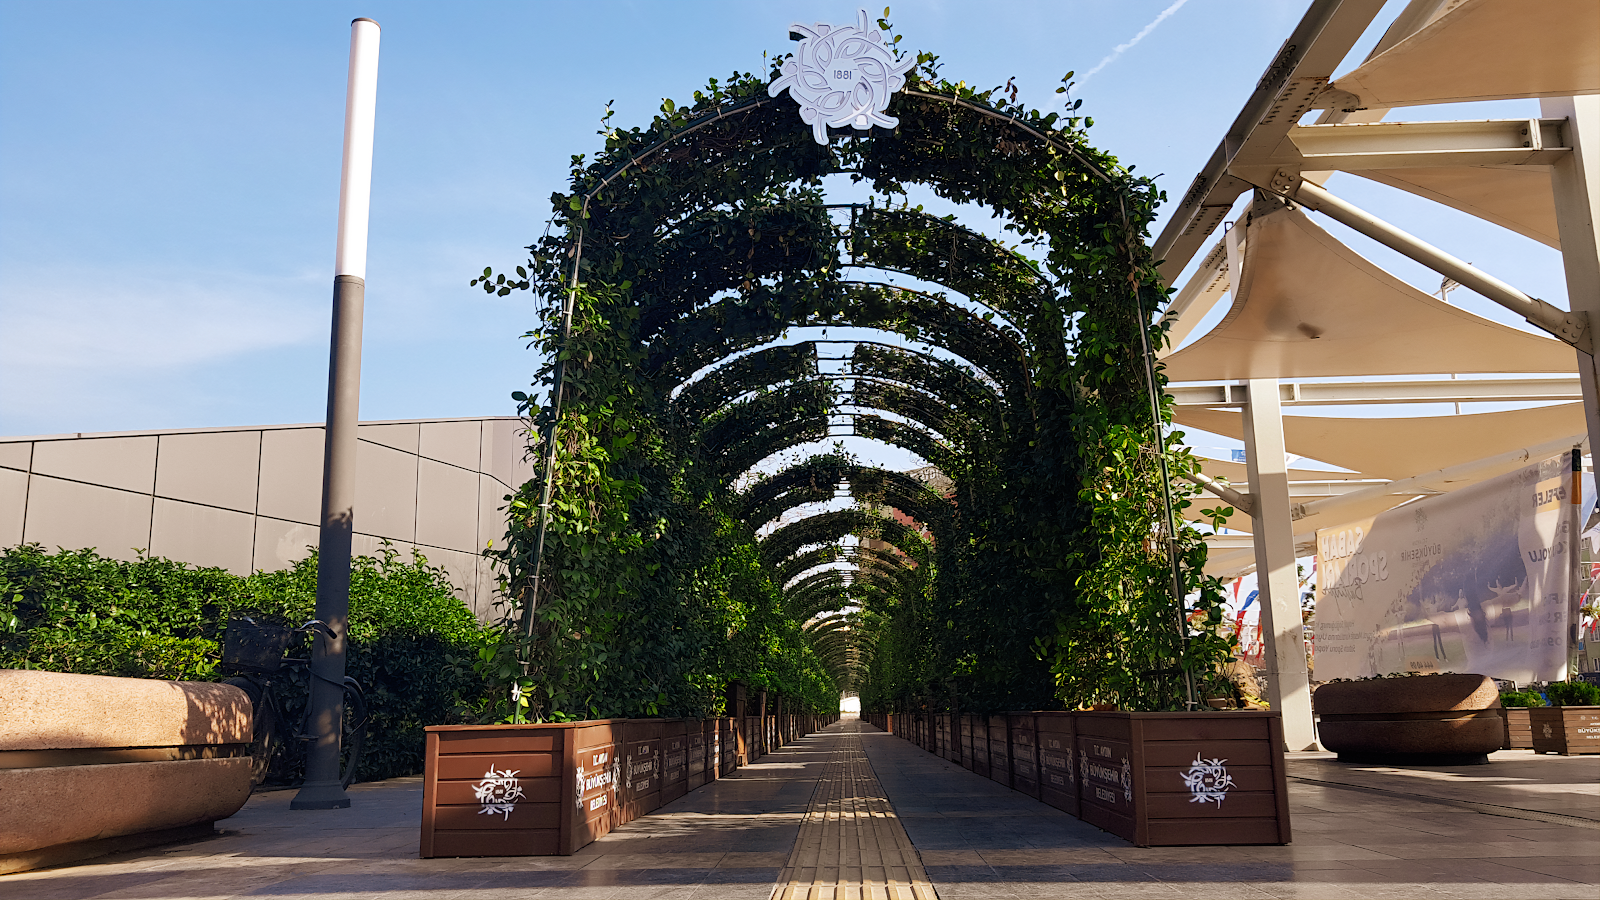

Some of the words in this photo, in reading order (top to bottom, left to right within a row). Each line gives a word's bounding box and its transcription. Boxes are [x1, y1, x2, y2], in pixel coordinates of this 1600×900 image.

[833, 70, 852, 80] 1881
[1100, 745, 1112, 758] AYDIN
[1090, 763, 1119, 783] BÜYÜKŞEHİR
[1096, 787, 1116, 804] BELEDİYESİ
